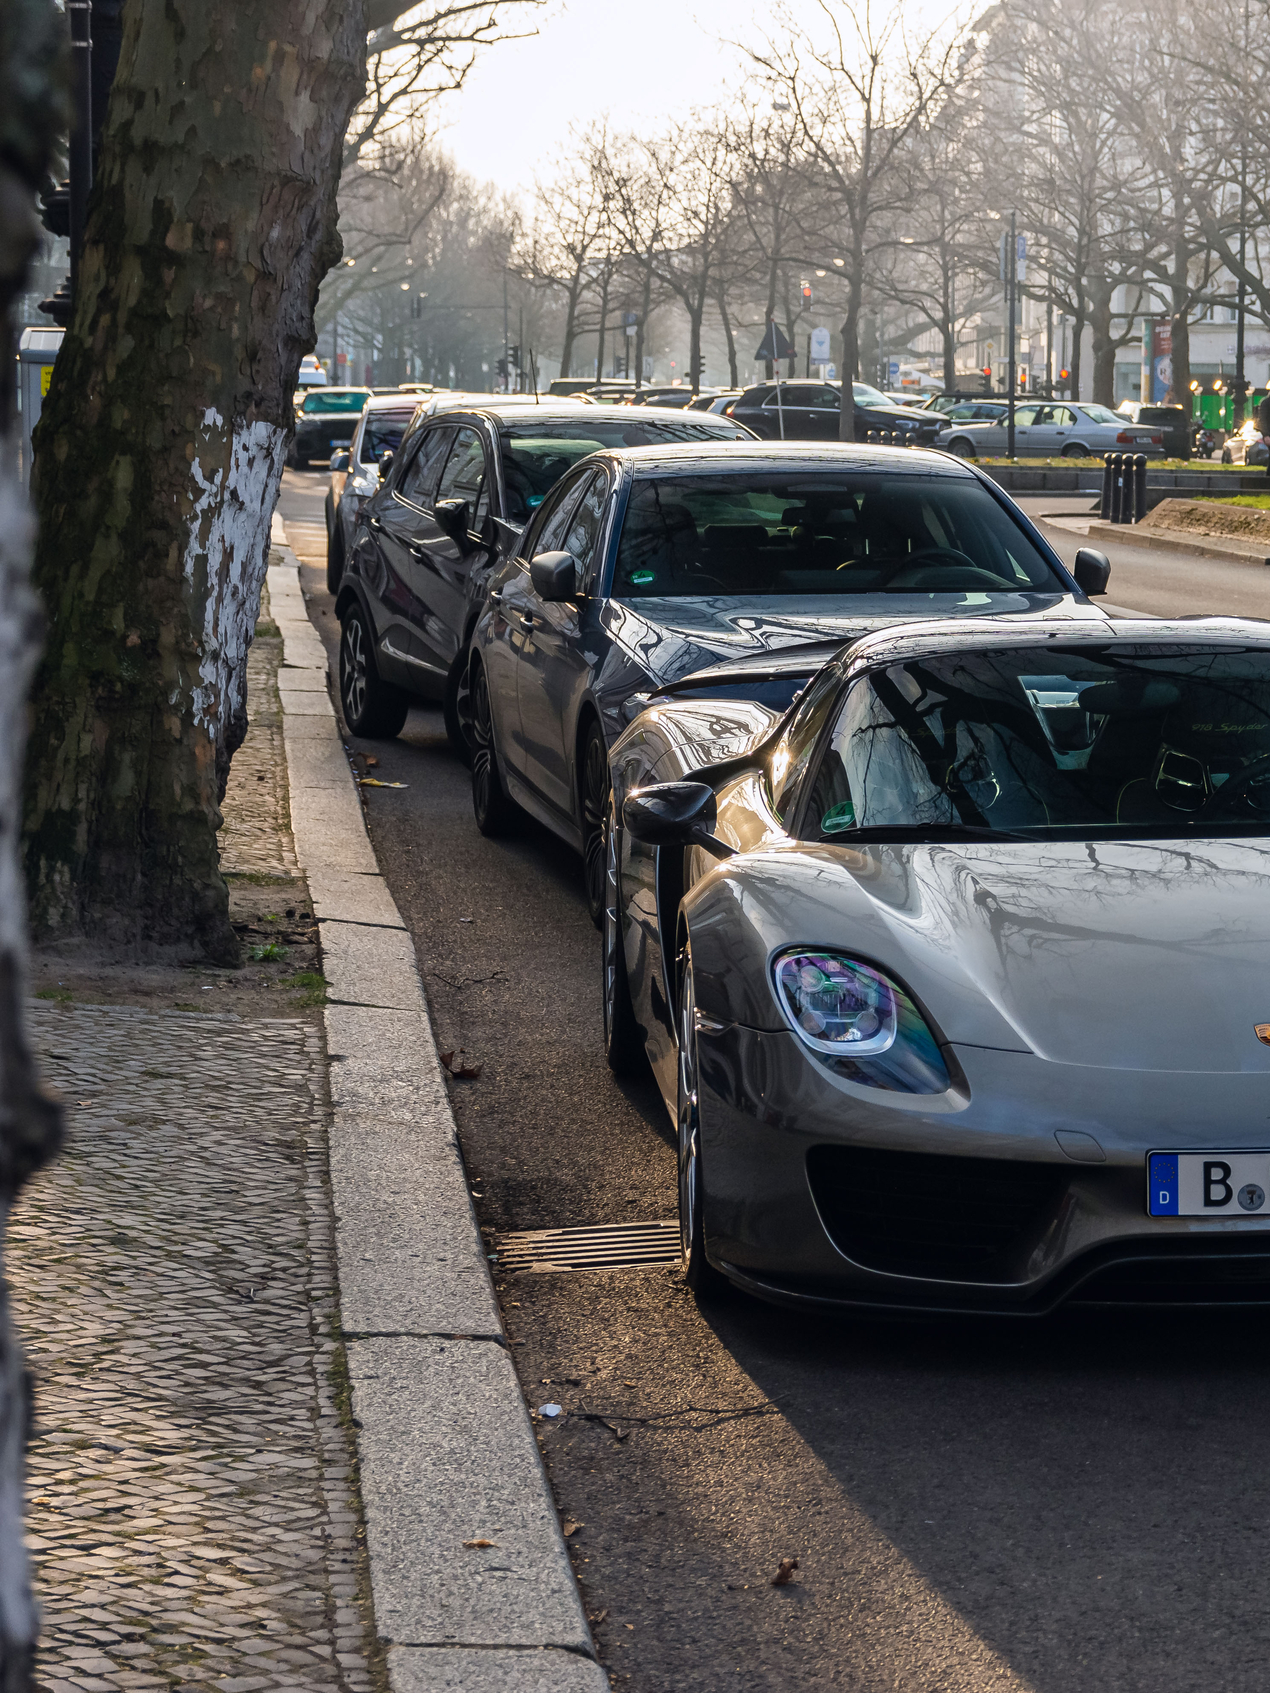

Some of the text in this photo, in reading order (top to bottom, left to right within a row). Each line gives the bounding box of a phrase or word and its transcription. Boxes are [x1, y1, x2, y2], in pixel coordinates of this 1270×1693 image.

[1191, 722, 1268, 734] 918 Spyder
[1203, 1161, 1234, 1207] B
[1159, 1191, 1170, 1204] D
